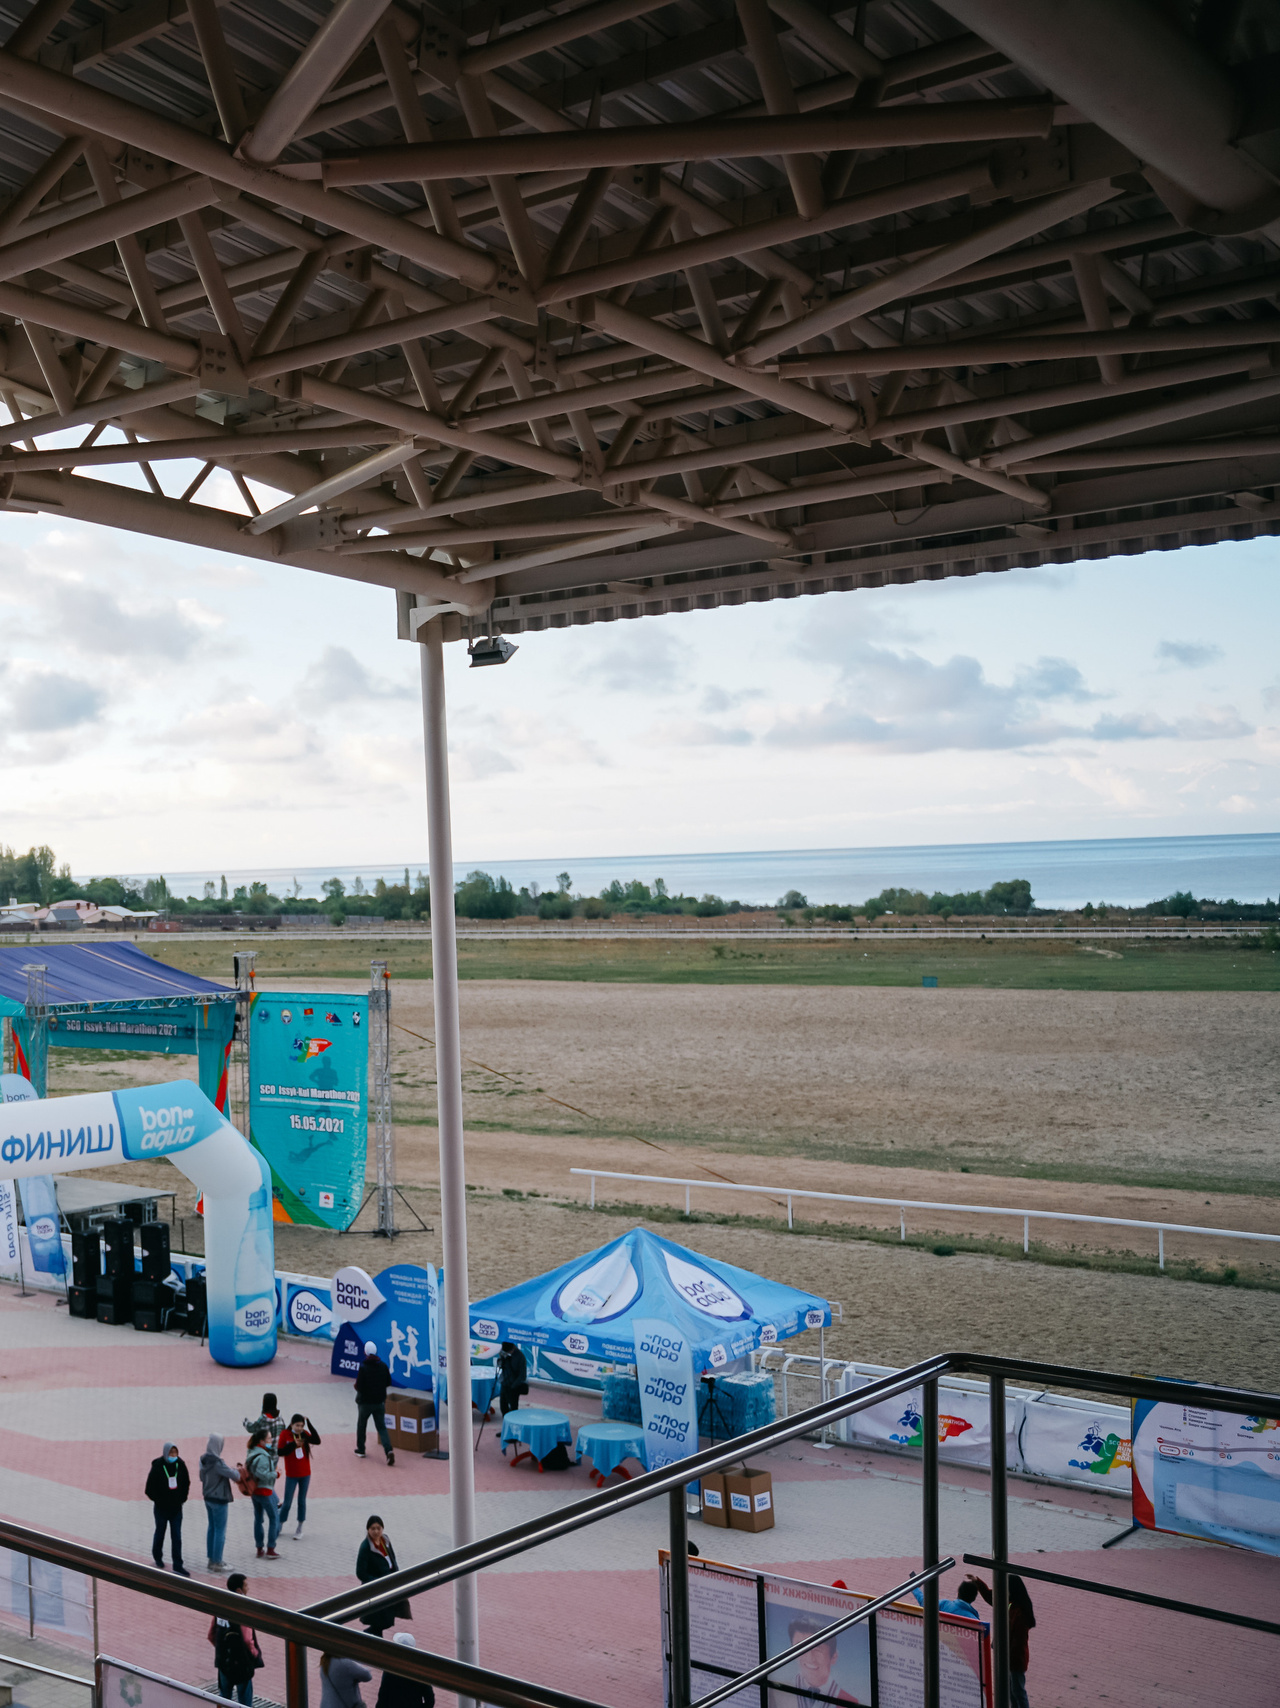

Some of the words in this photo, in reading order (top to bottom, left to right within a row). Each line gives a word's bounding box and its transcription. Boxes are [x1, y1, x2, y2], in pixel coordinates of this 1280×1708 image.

[66, 1019, 81, 1031] SCO
[83, 1020, 119, 1034] Issyk-Kul
[120, 1022, 158, 1036] Marathon
[158, 1024, 178, 1036] 2021
[6, 1093, 23, 1103] bon
[260, 1084, 276, 1095] SCO
[278, 1085, 310, 1098] Issyk-Kul
[310, 1088, 347, 1100] Marathon
[346, 1091, 360, 1103] 2021
[138, 1106, 184, 1131] bon
[289, 1114, 345, 1134] 15.05.2021
[1, 1123, 115, 1164] ФИНИШ
[140, 1125, 196, 1151] aqua
[336, 1279, 362, 1297] bon
[296, 1300, 317, 1313] bon
[336, 1294, 370, 1310] aqua
[245, 1309, 266, 1320] bon
[245, 1317, 270, 1328] aqua
[296, 1311, 322, 1324] aqua
[339, 1359, 360, 1371] 2021
